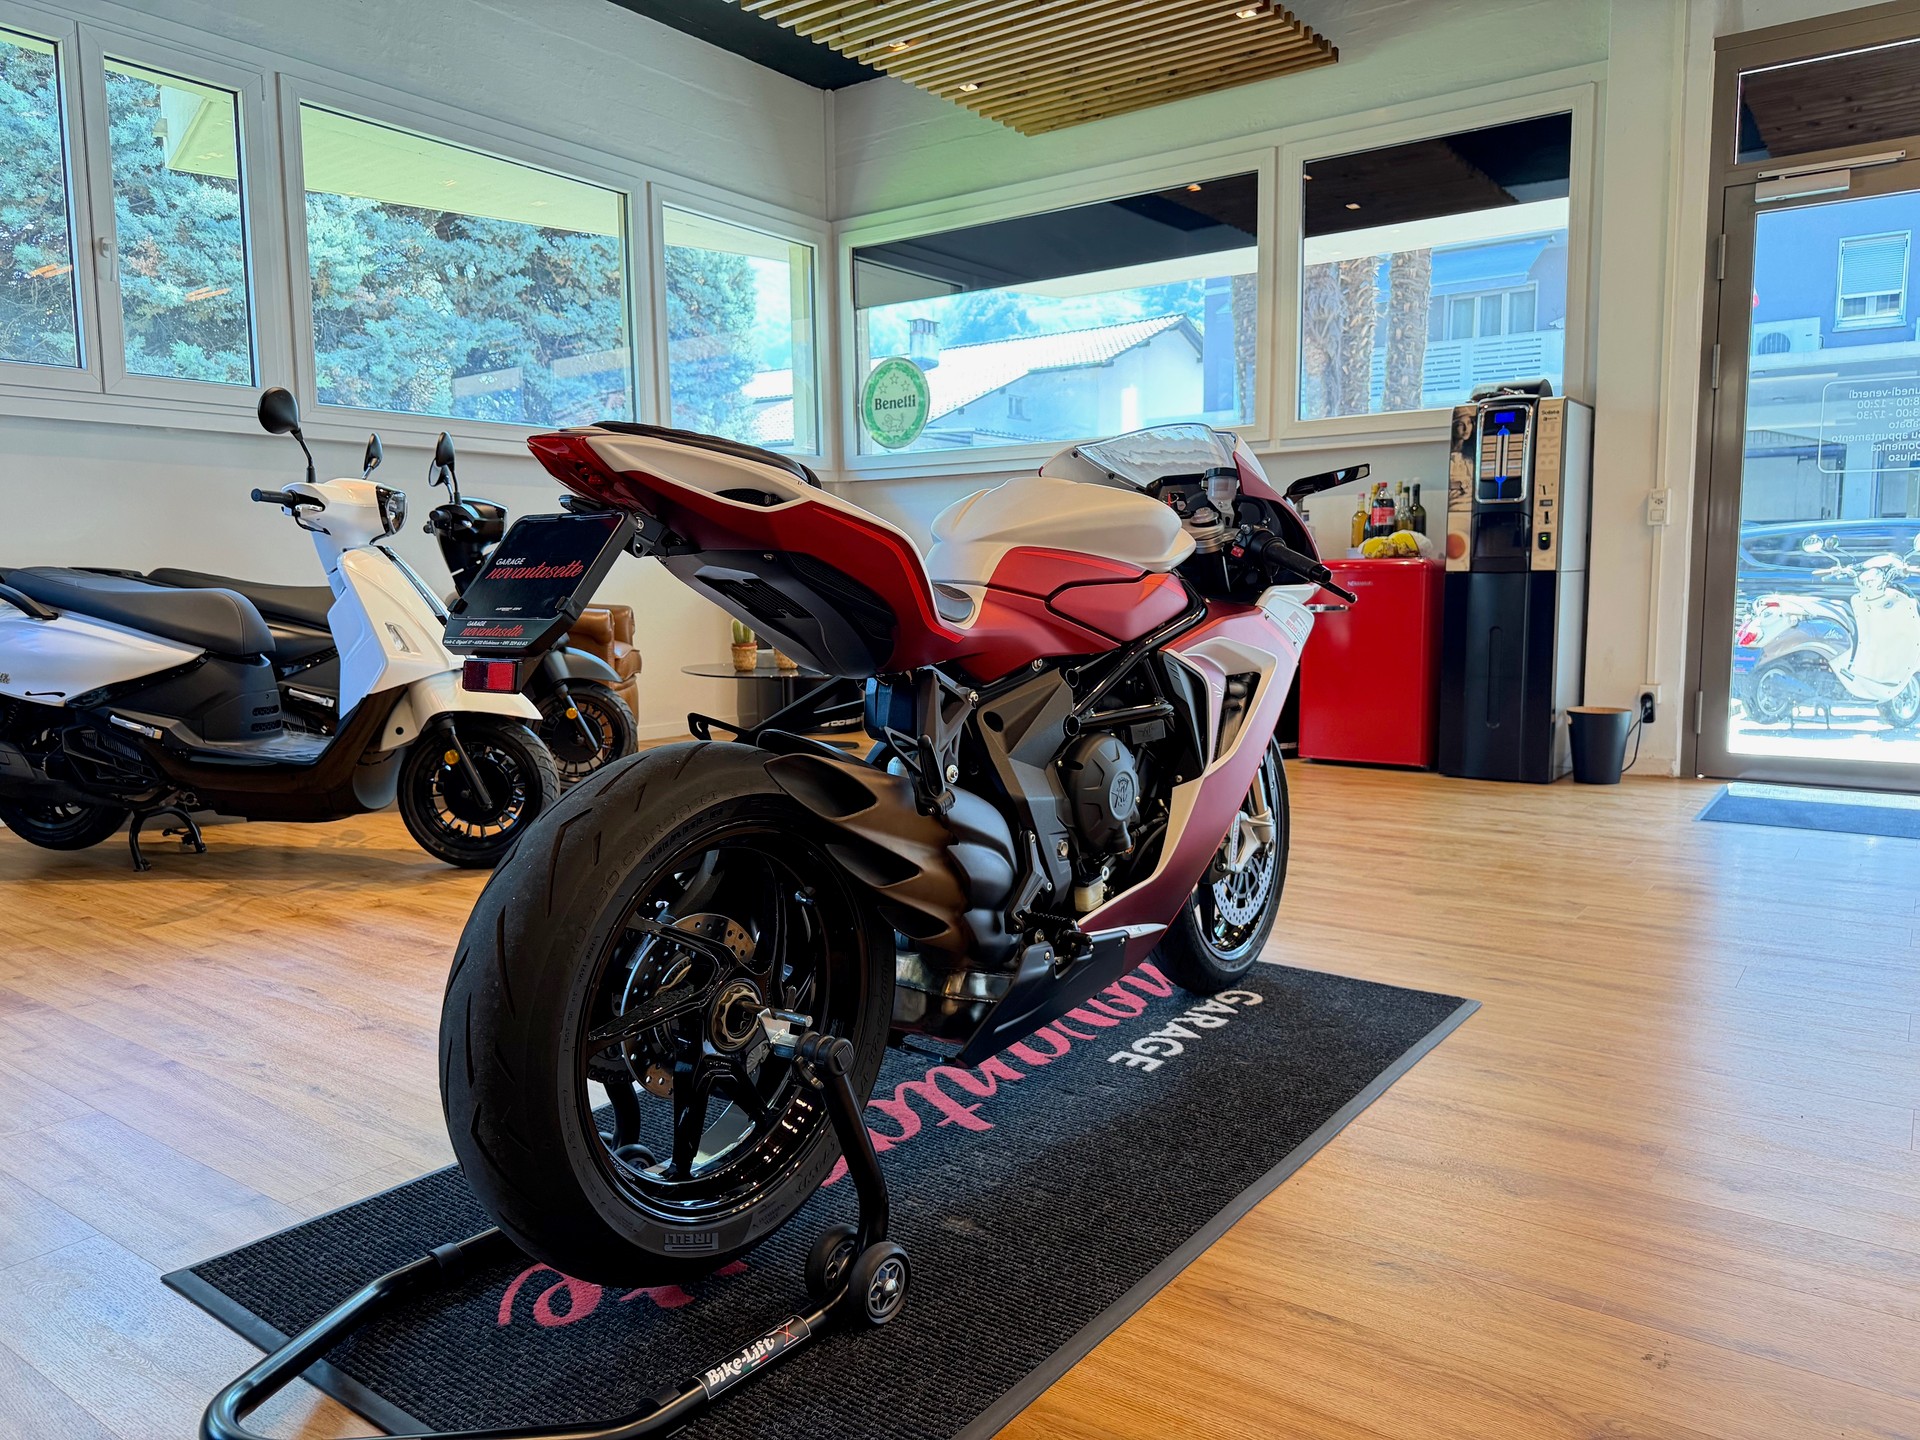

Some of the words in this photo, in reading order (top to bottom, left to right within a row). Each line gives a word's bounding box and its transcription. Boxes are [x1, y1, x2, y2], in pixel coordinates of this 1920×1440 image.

[874, 394, 916, 410] Benelli
[485, 560, 584, 579] novantasette
[496, 558, 526, 566] GARAGE
[1107, 989, 1264, 1073] GARAGE
[664, 1232, 718, 1251] PIRELLI
[705, 1337, 775, 1387] Bike-Lift
